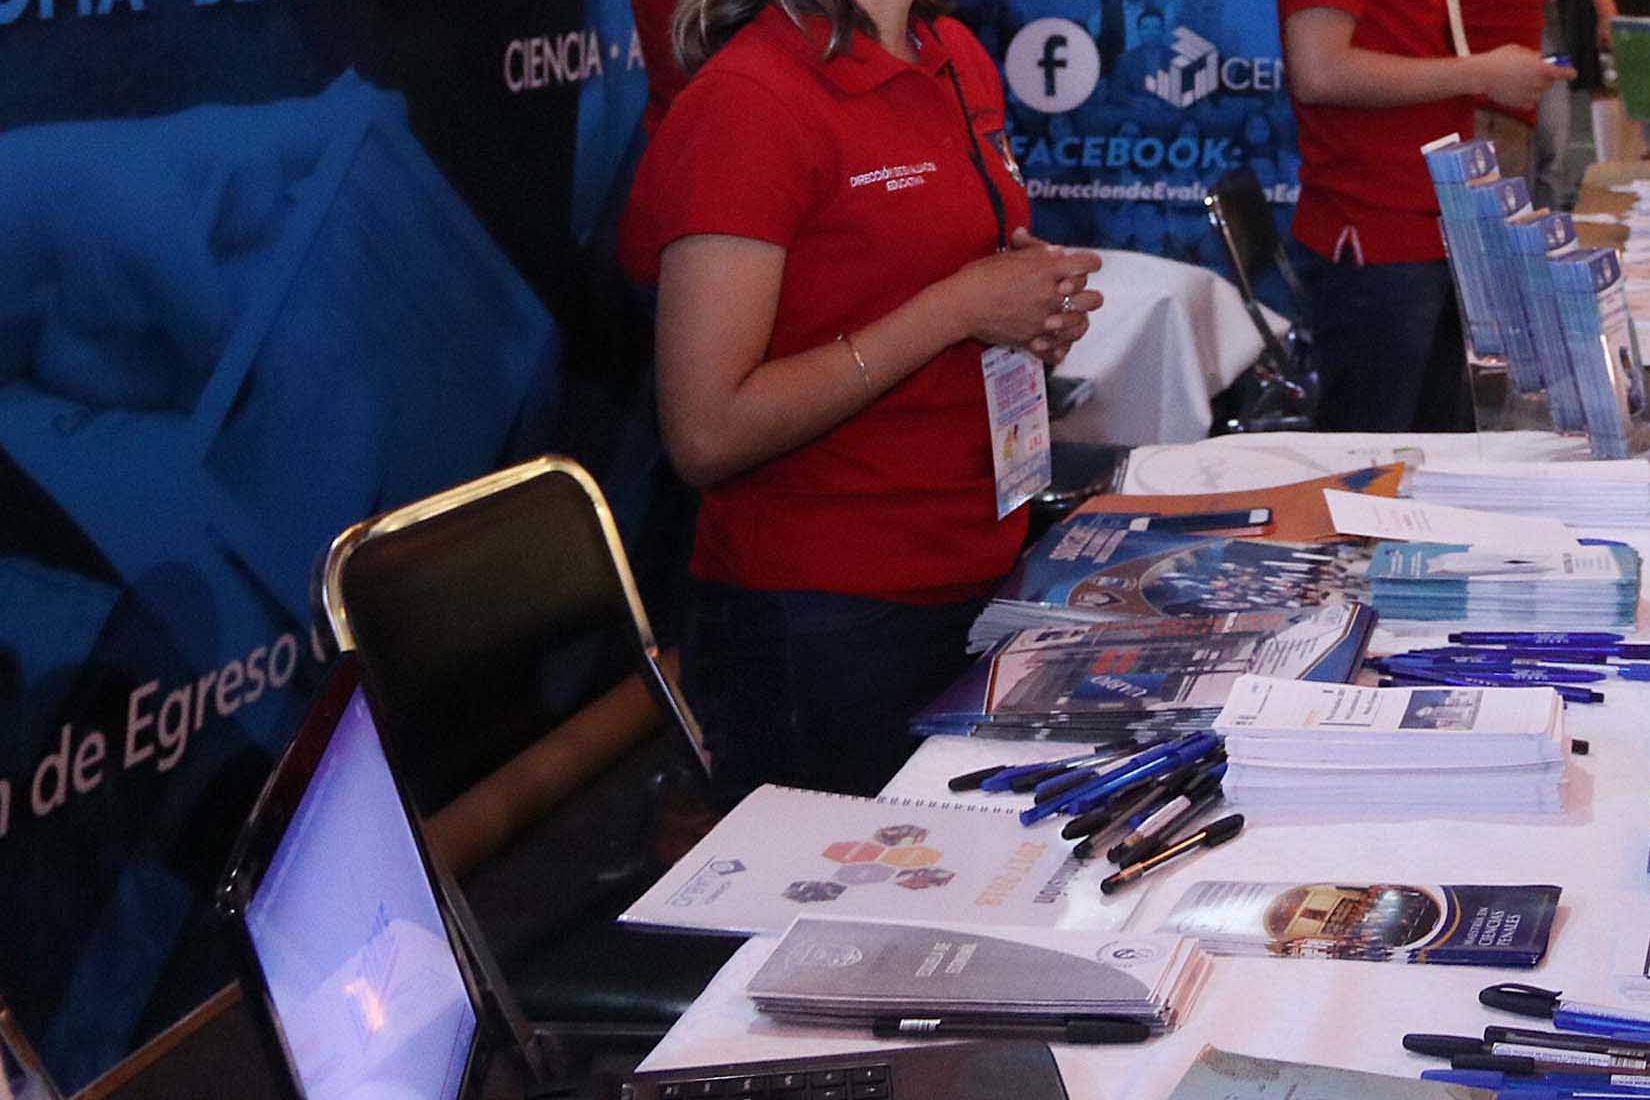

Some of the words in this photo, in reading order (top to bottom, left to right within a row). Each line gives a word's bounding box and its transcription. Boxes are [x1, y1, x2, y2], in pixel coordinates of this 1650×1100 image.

[503, 29, 603, 94] CIENCIA
[31, 722, 106, 816] de
[123, 633, 298, 772] Egreso
